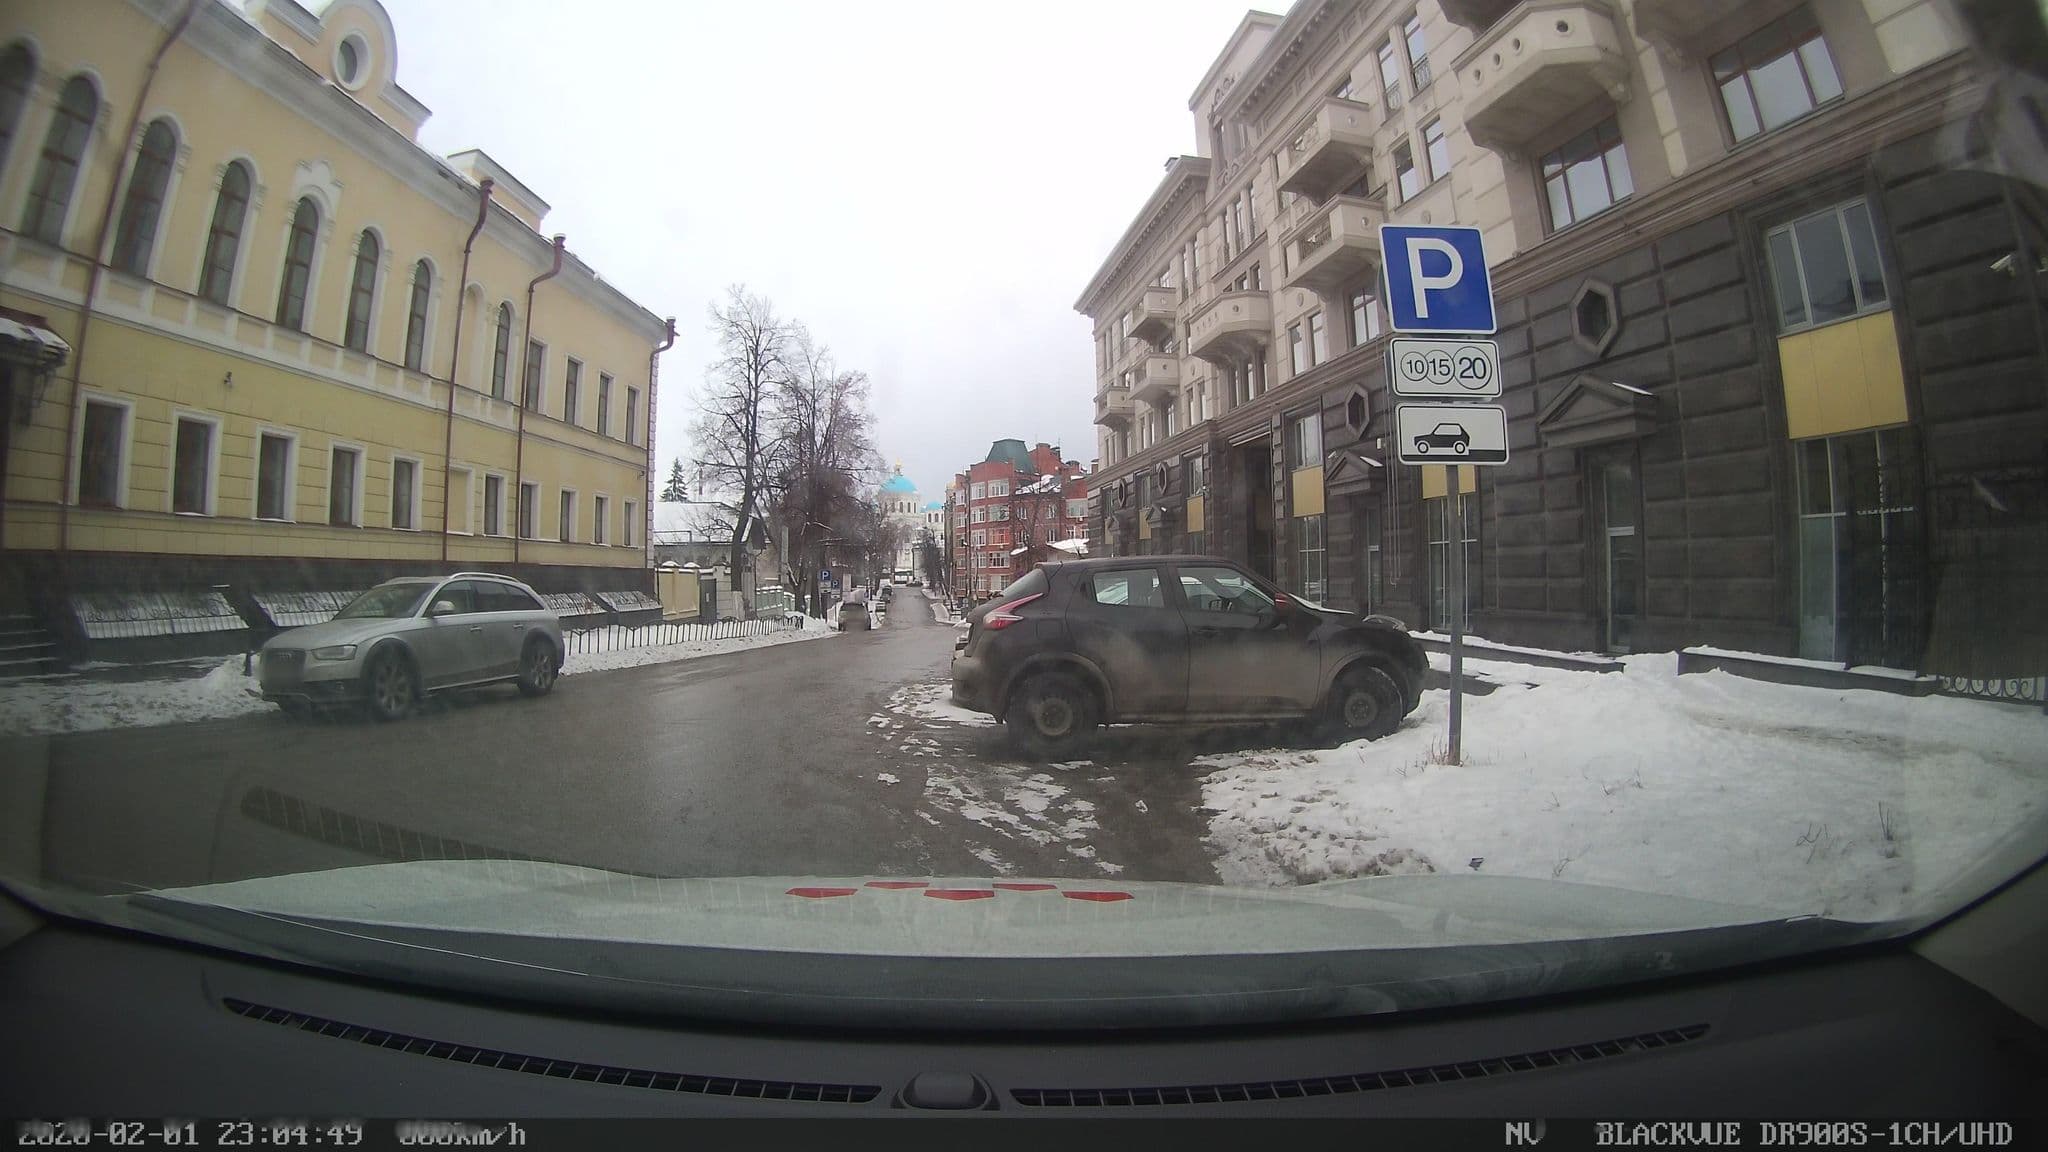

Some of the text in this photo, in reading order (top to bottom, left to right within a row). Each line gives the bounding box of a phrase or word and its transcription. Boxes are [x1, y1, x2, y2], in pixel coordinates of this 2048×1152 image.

[1405, 237, 1464, 319] P
[1406, 357, 1486, 380] 10 15 20
